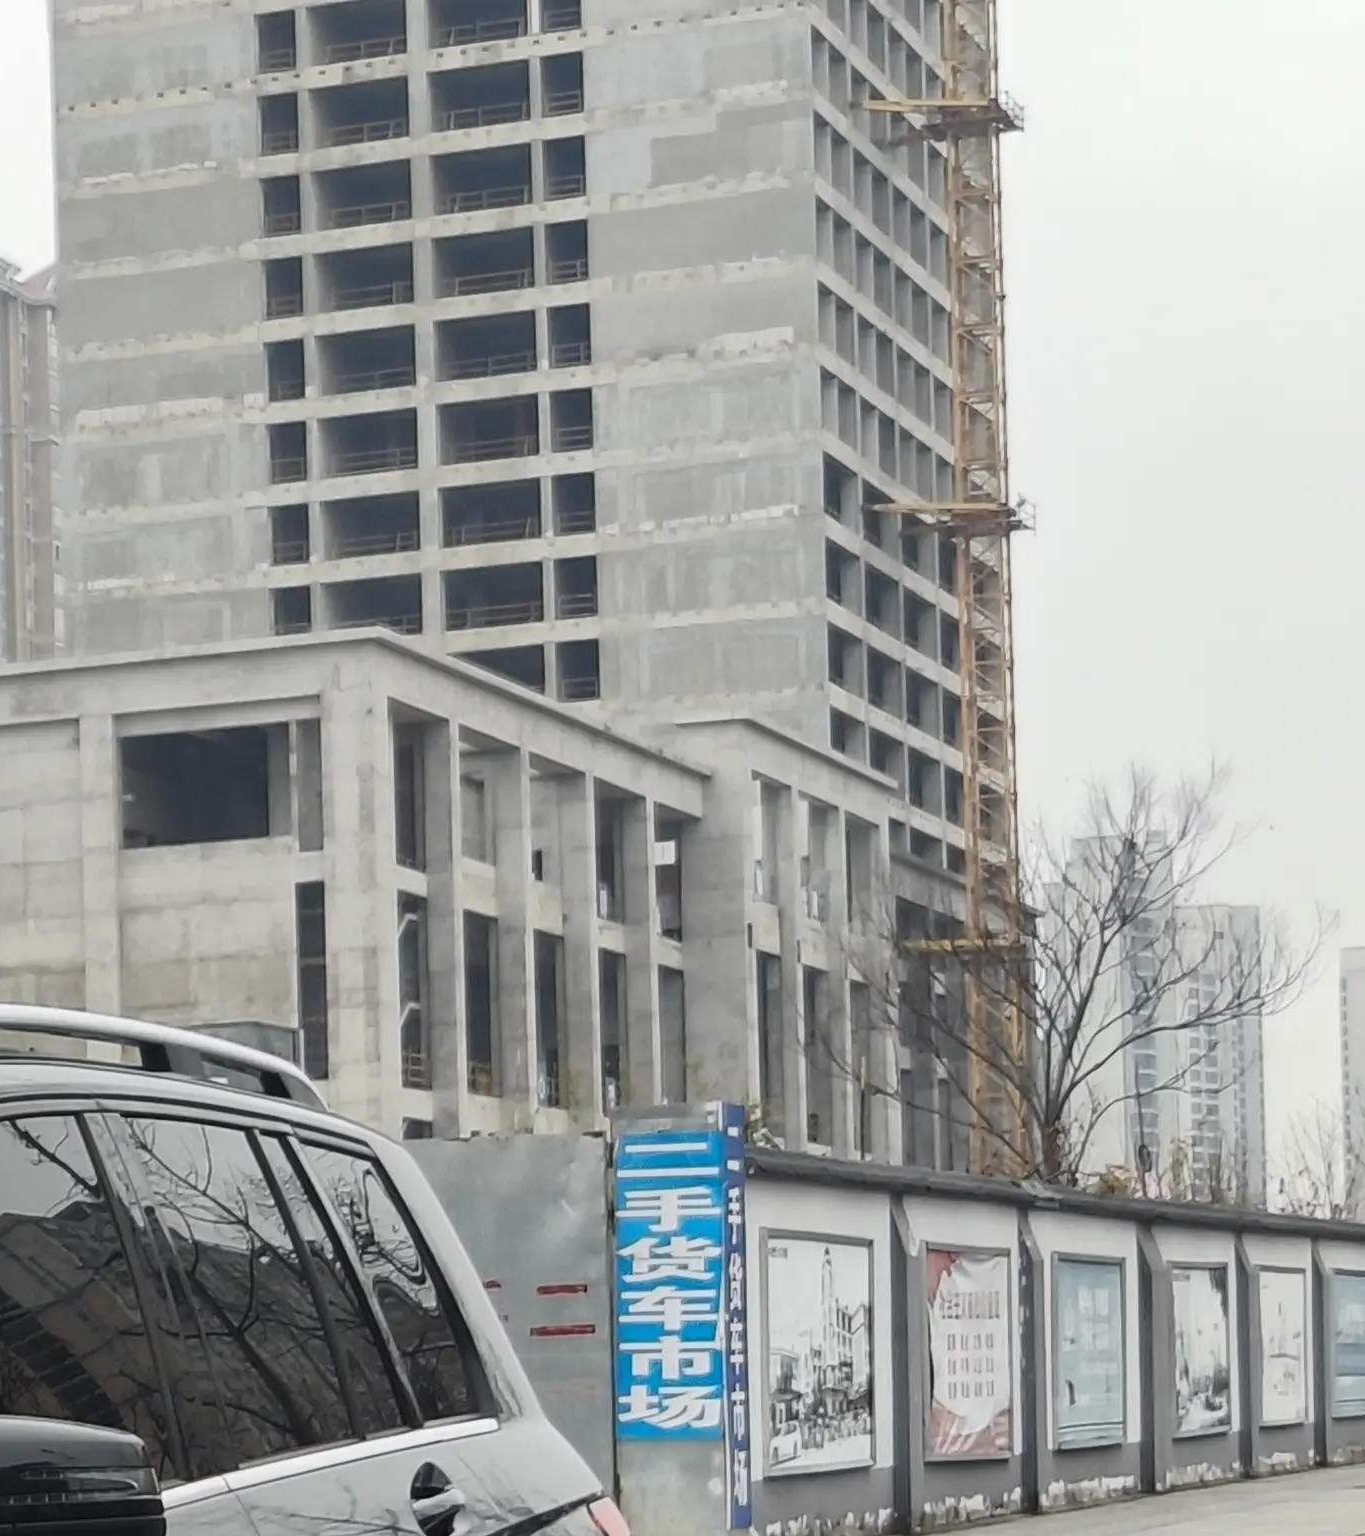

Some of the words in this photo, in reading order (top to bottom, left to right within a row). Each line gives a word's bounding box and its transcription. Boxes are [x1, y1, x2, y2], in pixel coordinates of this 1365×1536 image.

[615, 1141, 723, 1429] 二手货车市场
[726, 1126, 748, 1507] 二手货车市场
